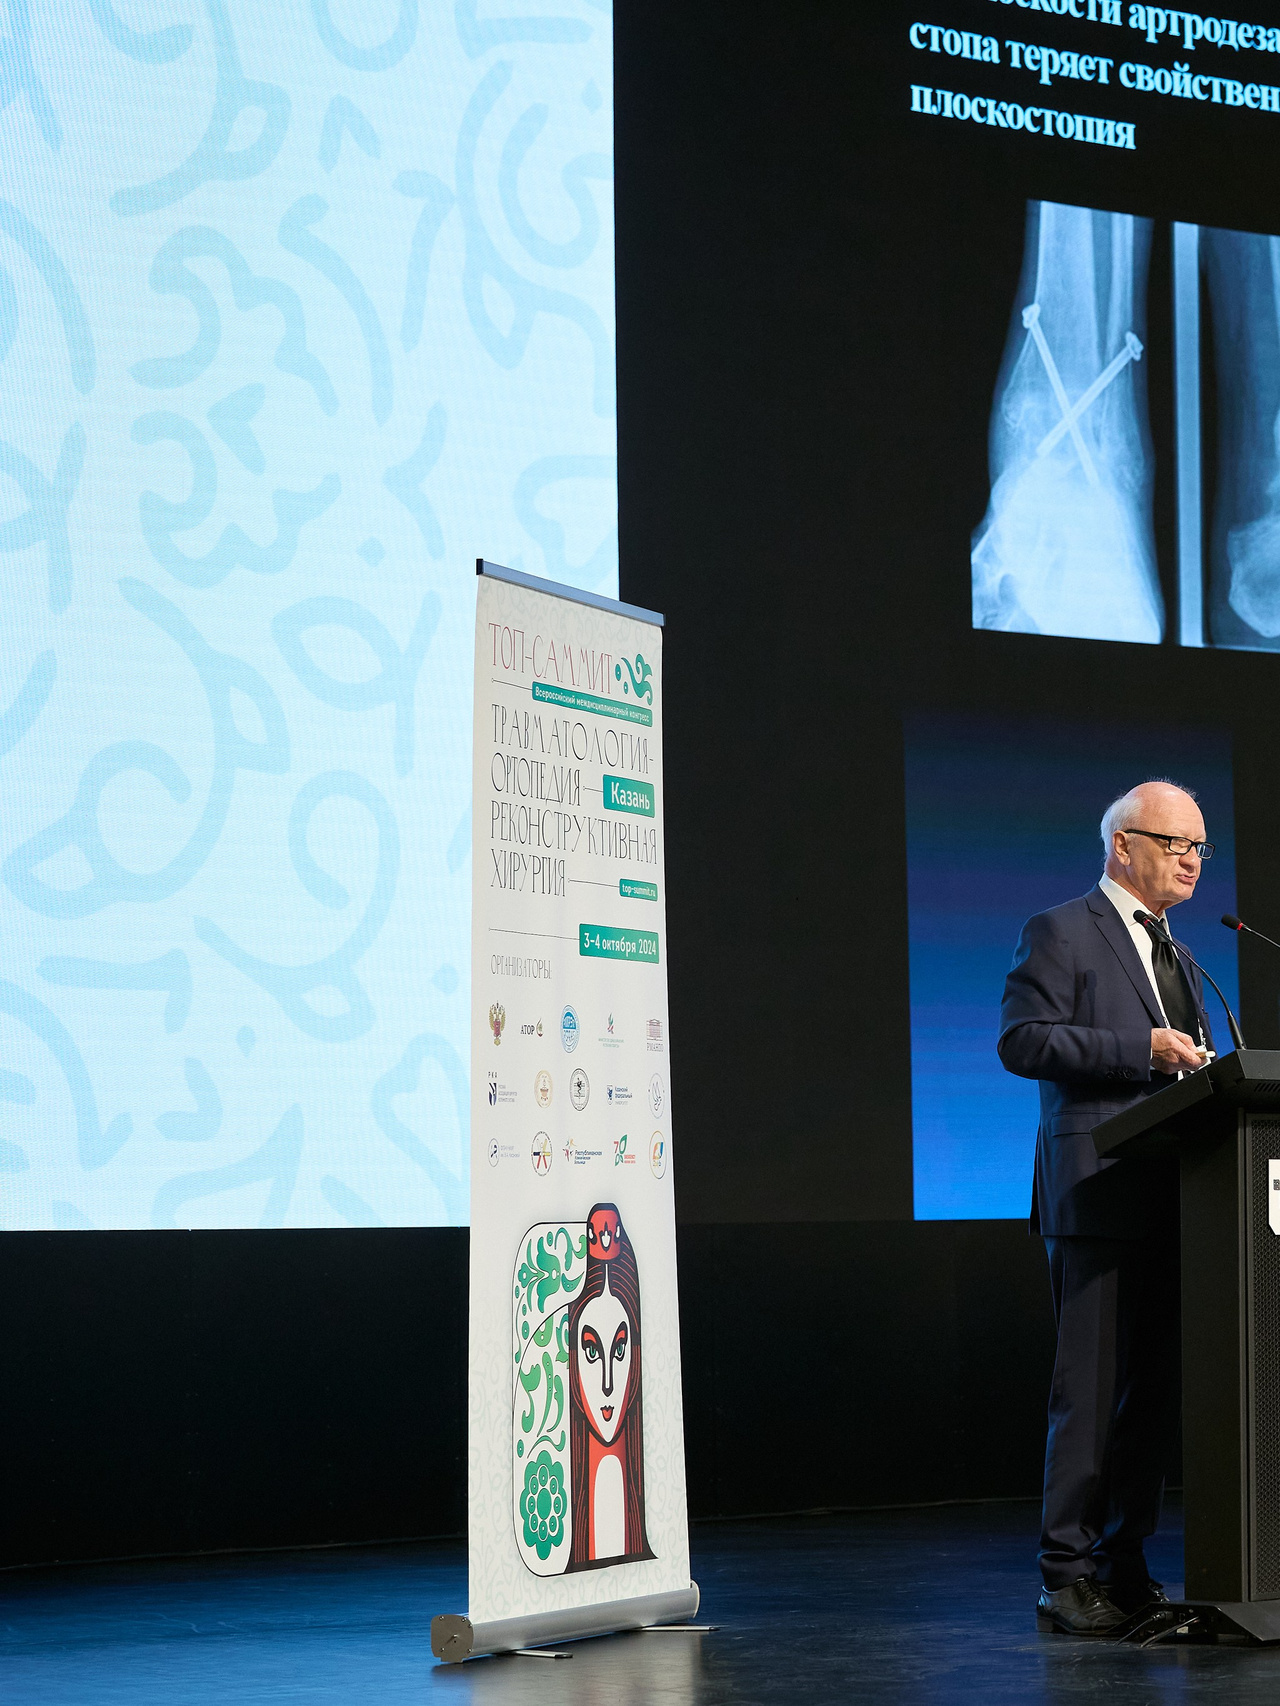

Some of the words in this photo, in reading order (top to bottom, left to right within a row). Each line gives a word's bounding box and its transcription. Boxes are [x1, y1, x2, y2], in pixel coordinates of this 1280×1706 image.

[909, 21, 1001, 65] стопа
[1004, 39, 1115, 86] теряет
[909, 84, 1137, 150] плоскостопия
[488, 622, 613, 695] ТОП-САММИТ
[535, 686, 576, 706] Всероссийский
[490, 752, 581, 807] ОРТОПЕДИЯ
[611, 781, 650, 810] Казань
[490, 800, 658, 865] РЕКОНСТРУКТИВНАЯ
[490, 848, 566, 897] ХИРУРГИЯ
[601, 938, 637, 957] октября
[638, 938, 657, 956] 2024
